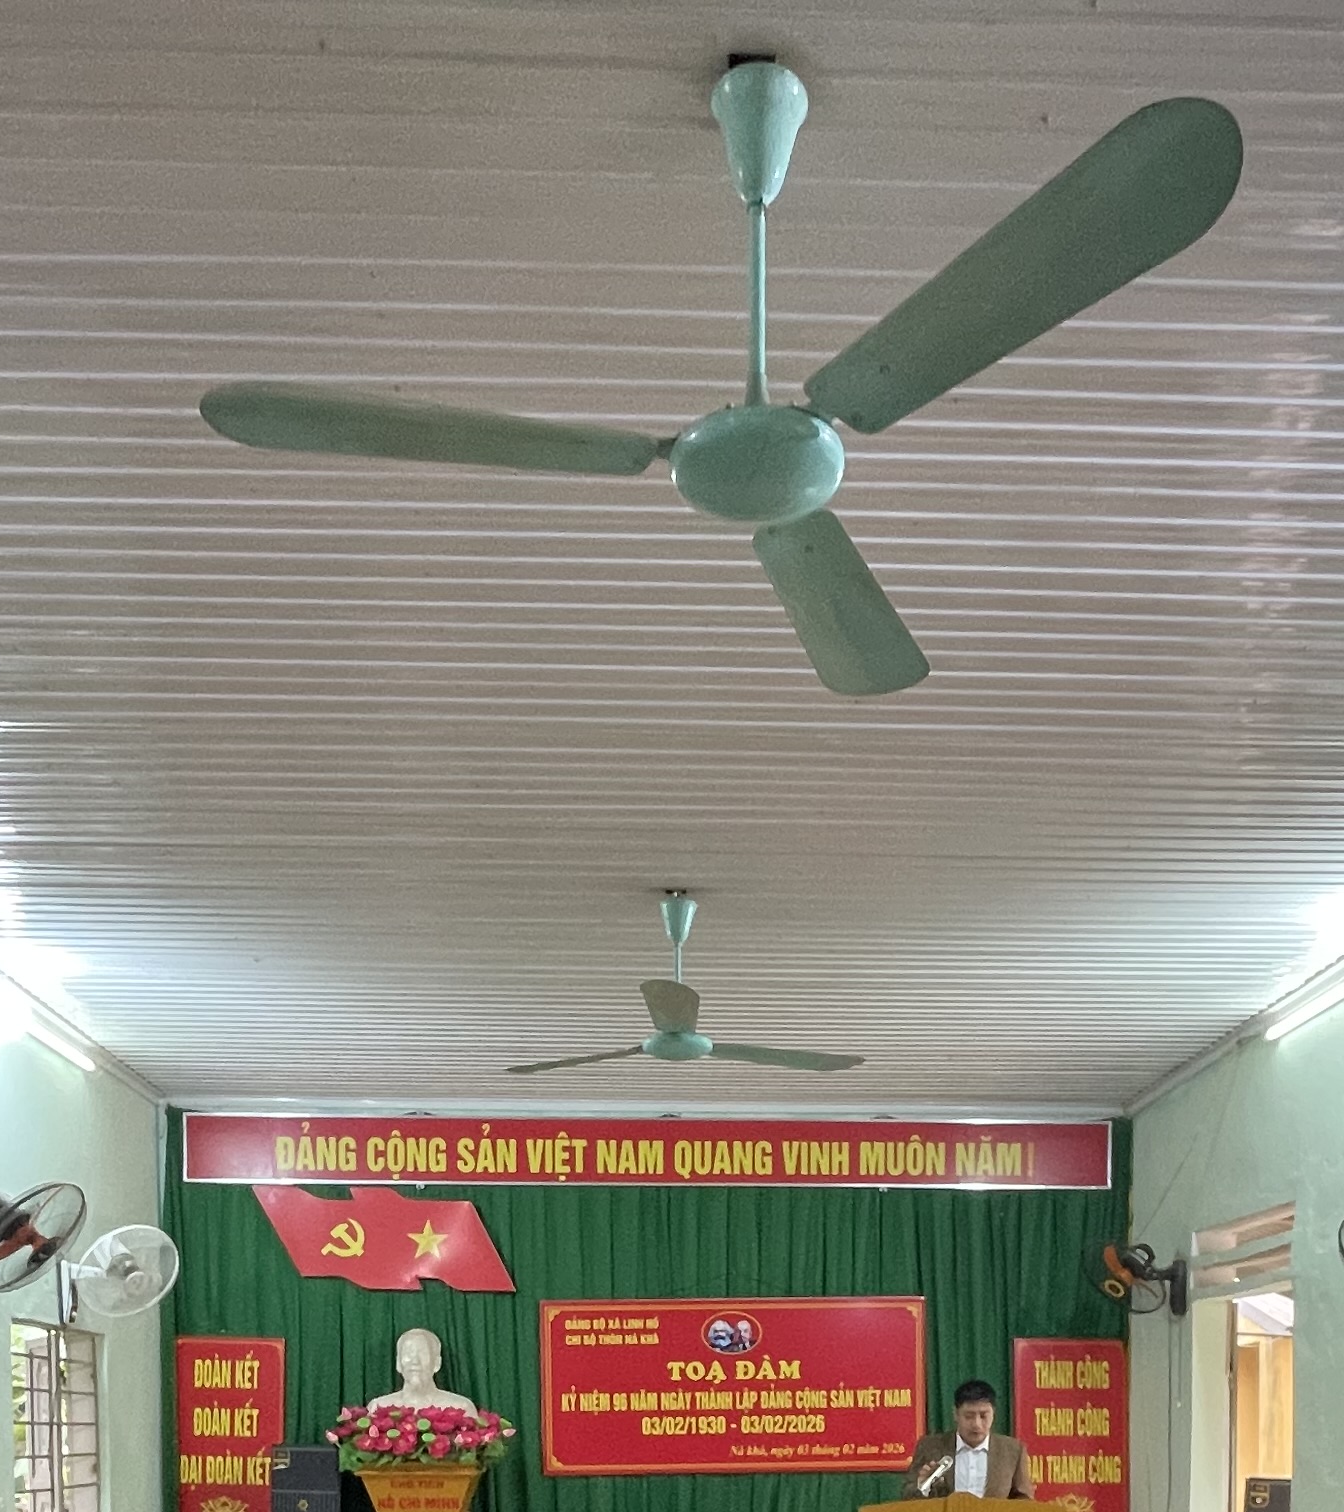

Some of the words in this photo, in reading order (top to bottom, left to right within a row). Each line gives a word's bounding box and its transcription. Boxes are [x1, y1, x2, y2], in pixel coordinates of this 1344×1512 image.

[275, 1121, 357, 1172] ĐẢNG
[366, 1130, 447, 1180] CỘNG
[457, 1122, 517, 1174] SẢN
[526, 1131, 587, 1181] VIỆT
[596, 1140, 664, 1175] NAM
[674, 1140, 773, 1179] QUANG
[782, 1141, 850, 1176] VINH
[859, 1134, 946, 1176] MUÔN
[194, 1353, 232, 1388] ĐOÀN
[235, 1350, 260, 1389] KẾT
[667, 1360, 727, 1384] TOẠ
[735, 1354, 801, 1380] ĐÀM
[1034, 1354, 1074, 1389] THÀNH
[1076, 1354, 1110, 1389] CÔNG
[561, 1385, 576, 1412] KỶ
[580, 1388, 610, 1415] NIỆM
[630, 1388, 658, 1411] NĂM
[661, 1388, 692, 1411] NGÀY
[696, 1387, 733, 1411] THÀNH
[736, 1386, 757, 1413] LẬP
[760, 1383, 792, 1409] ĐẢNG
[795, 1386, 827, 1413] CỘNG
[830, 1381, 854, 1408] SẢN
[857, 1386, 881, 1412] VIỆT
[884, 1388, 912, 1408] NAM
[193, 1401, 231, 1437] ĐOÀN
[234, 1398, 260, 1437] KẾT
[641, 1415, 727, 1436] 03/02/1930
[740, 1414, 826, 1434] 03/02/2026
[1034, 1402, 1074, 1436] THÀNH
[1077, 1402, 1110, 1437] CÔNG
[180, 1455, 202, 1491] ĐẠI
[206, 1449, 243, 1485] ĐOÀN
[247, 1447, 272, 1486] KẾT
[1046, 1449, 1086, 1485] THÀNH
[1088, 1449, 1121, 1485] CÔNG
